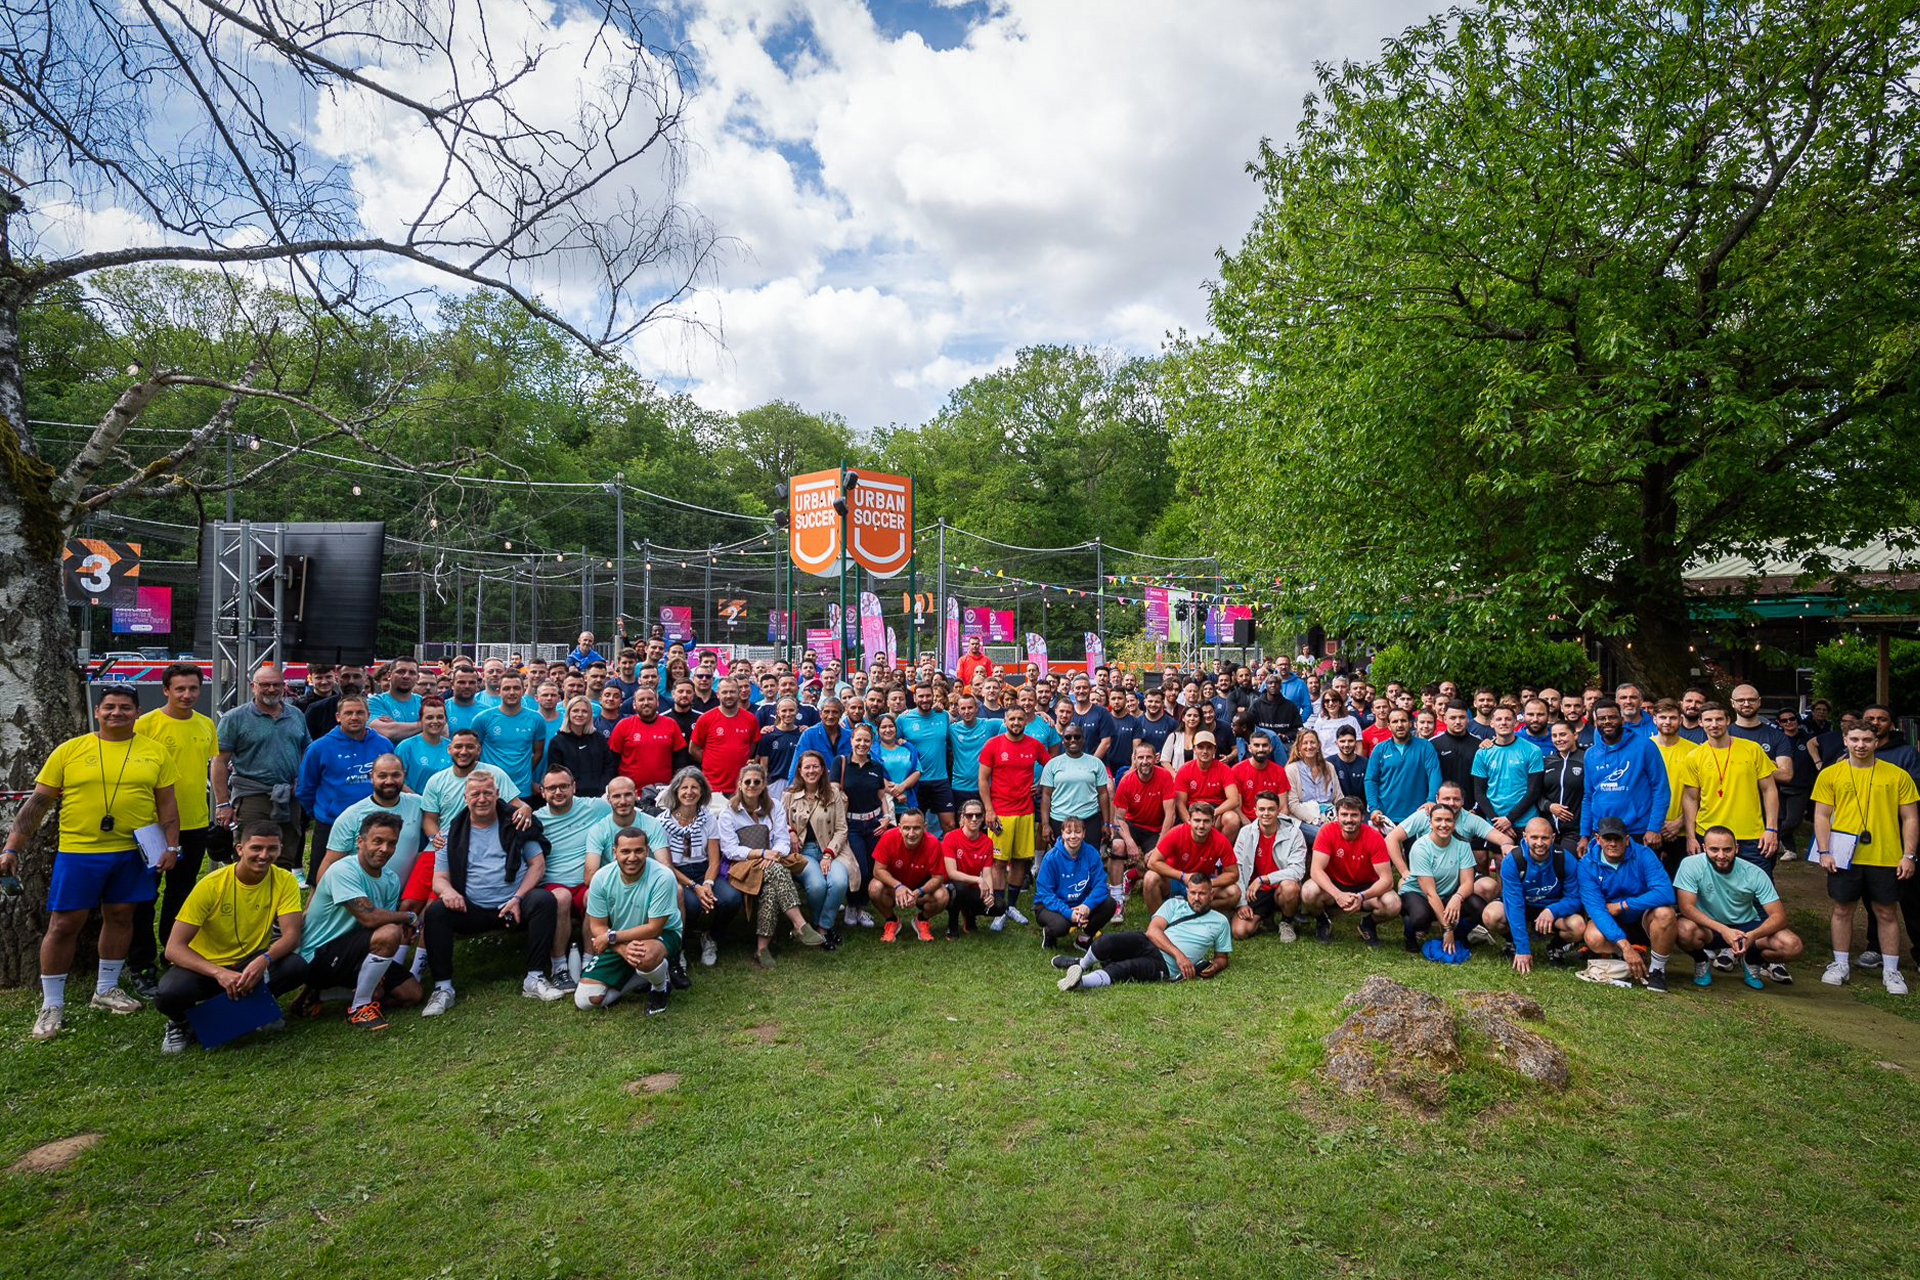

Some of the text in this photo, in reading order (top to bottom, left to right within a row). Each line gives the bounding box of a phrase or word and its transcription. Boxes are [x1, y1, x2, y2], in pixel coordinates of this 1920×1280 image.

[795, 489, 835, 512] URBAN
[854, 489, 905, 512] URBAN
[795, 509, 835, 529] SOCCER
[854, 508, 905, 529] SOCCER
[80, 554, 112, 592] 3
[727, 606, 738, 625] 2
[914, 602, 925, 624] 1
